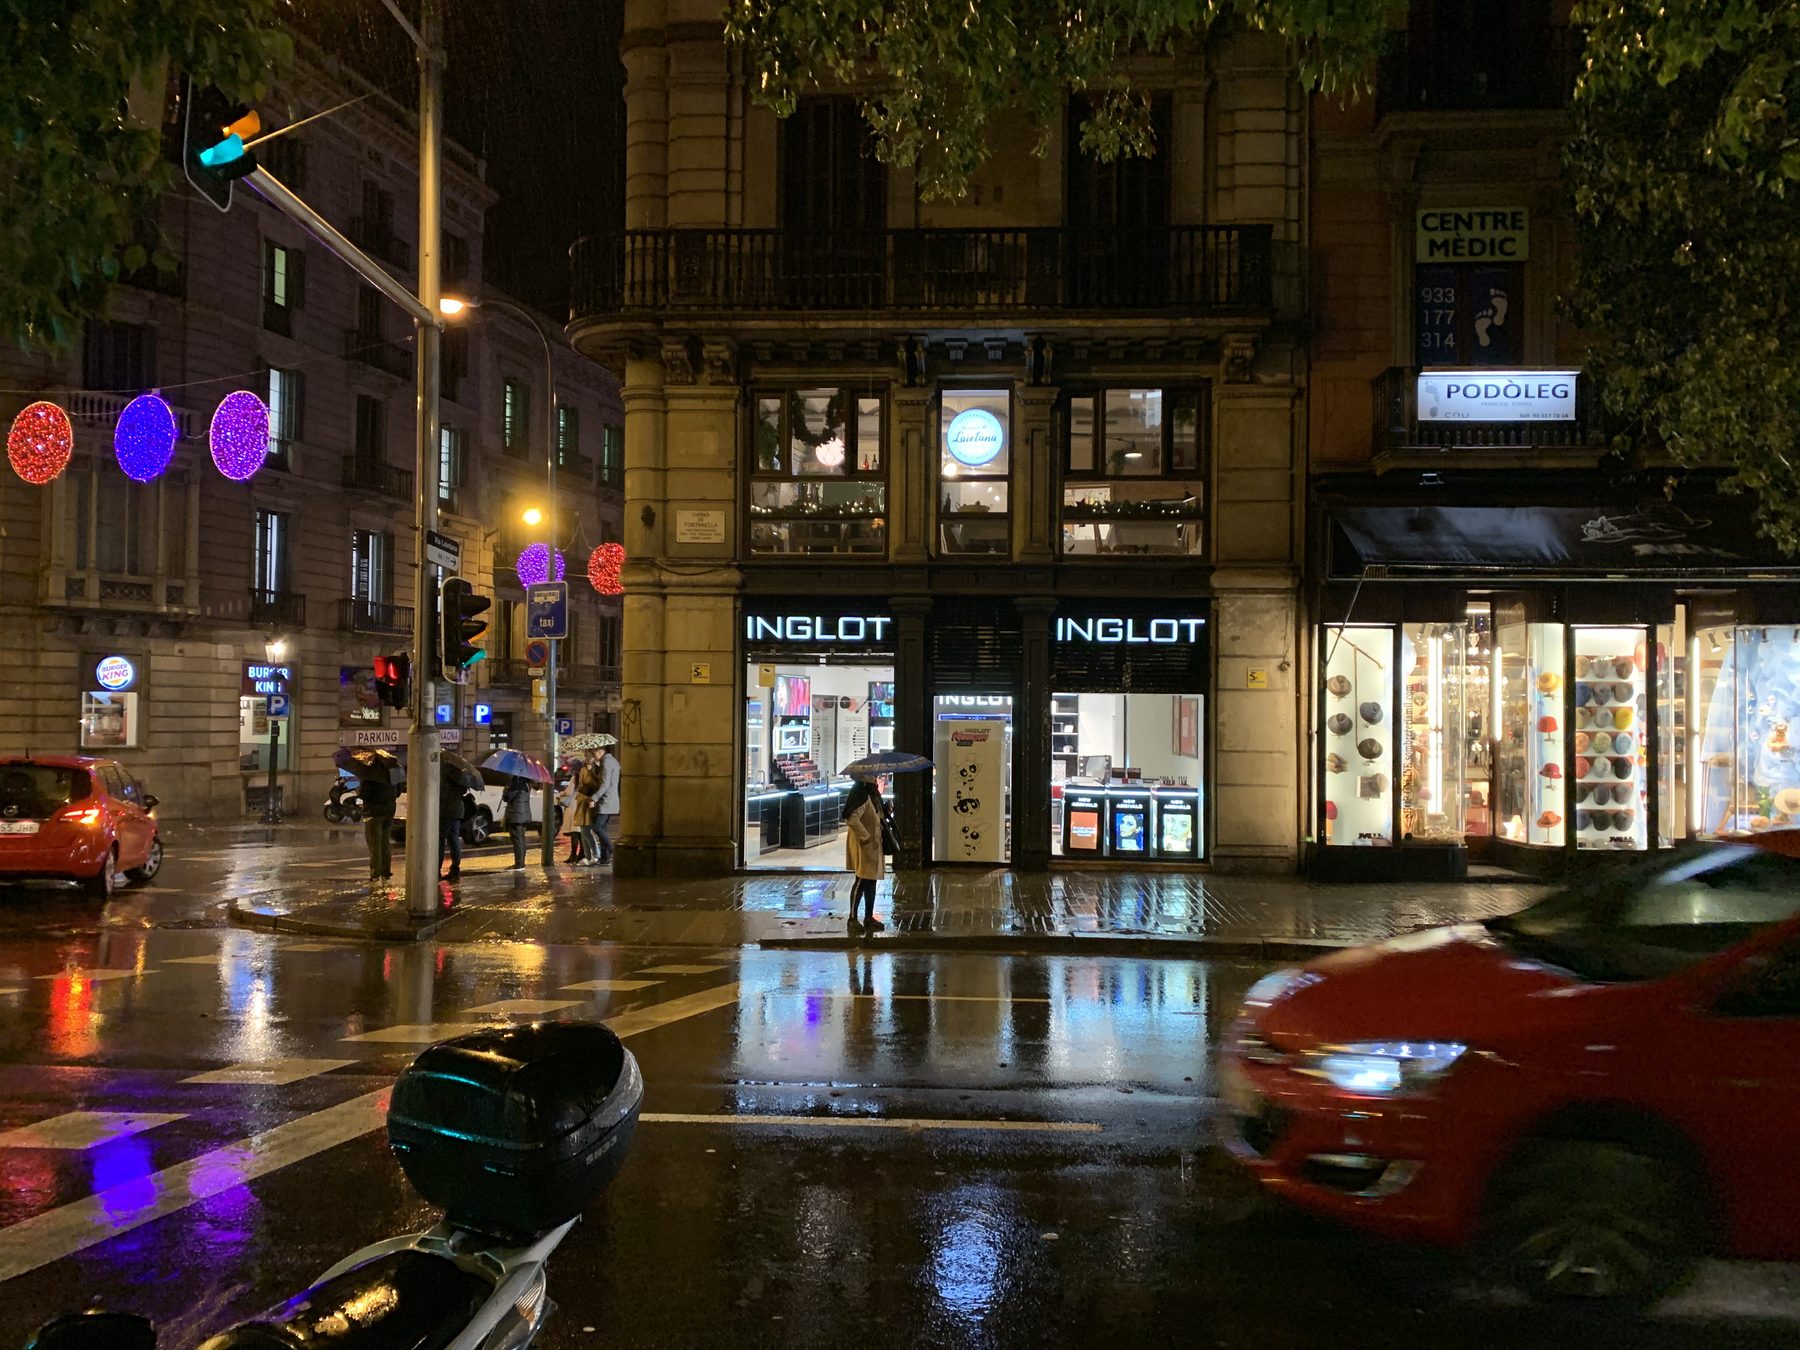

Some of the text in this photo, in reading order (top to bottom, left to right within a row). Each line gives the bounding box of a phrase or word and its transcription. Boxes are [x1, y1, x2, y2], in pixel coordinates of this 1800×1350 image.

[1421, 211, 1525, 231] CENTRE
[1428, 232, 1517, 257] MÈDIC
[1422, 287, 1455, 303] 933
[1422, 309, 1455, 325] 177
[1422, 332, 1455, 348] 314
[1446, 379, 1569, 399] PODÒLEG
[540, 616, 554, 627] taxi
[746, 616, 891, 640] INGLOT
[1057, 617, 1206, 643] INGLOT
[102, 664, 128, 672] BURGER
[102, 670, 128, 680] KING
[248, 666, 288, 680] BURR
[270, 696, 285, 714] P
[475, 704, 489, 722] P
[560, 718, 571, 734] P
[358, 732, 397, 743] PARKING
[1403, 763, 1413, 795] ONLINE
[1403, 796, 1413, 819] SHOP
